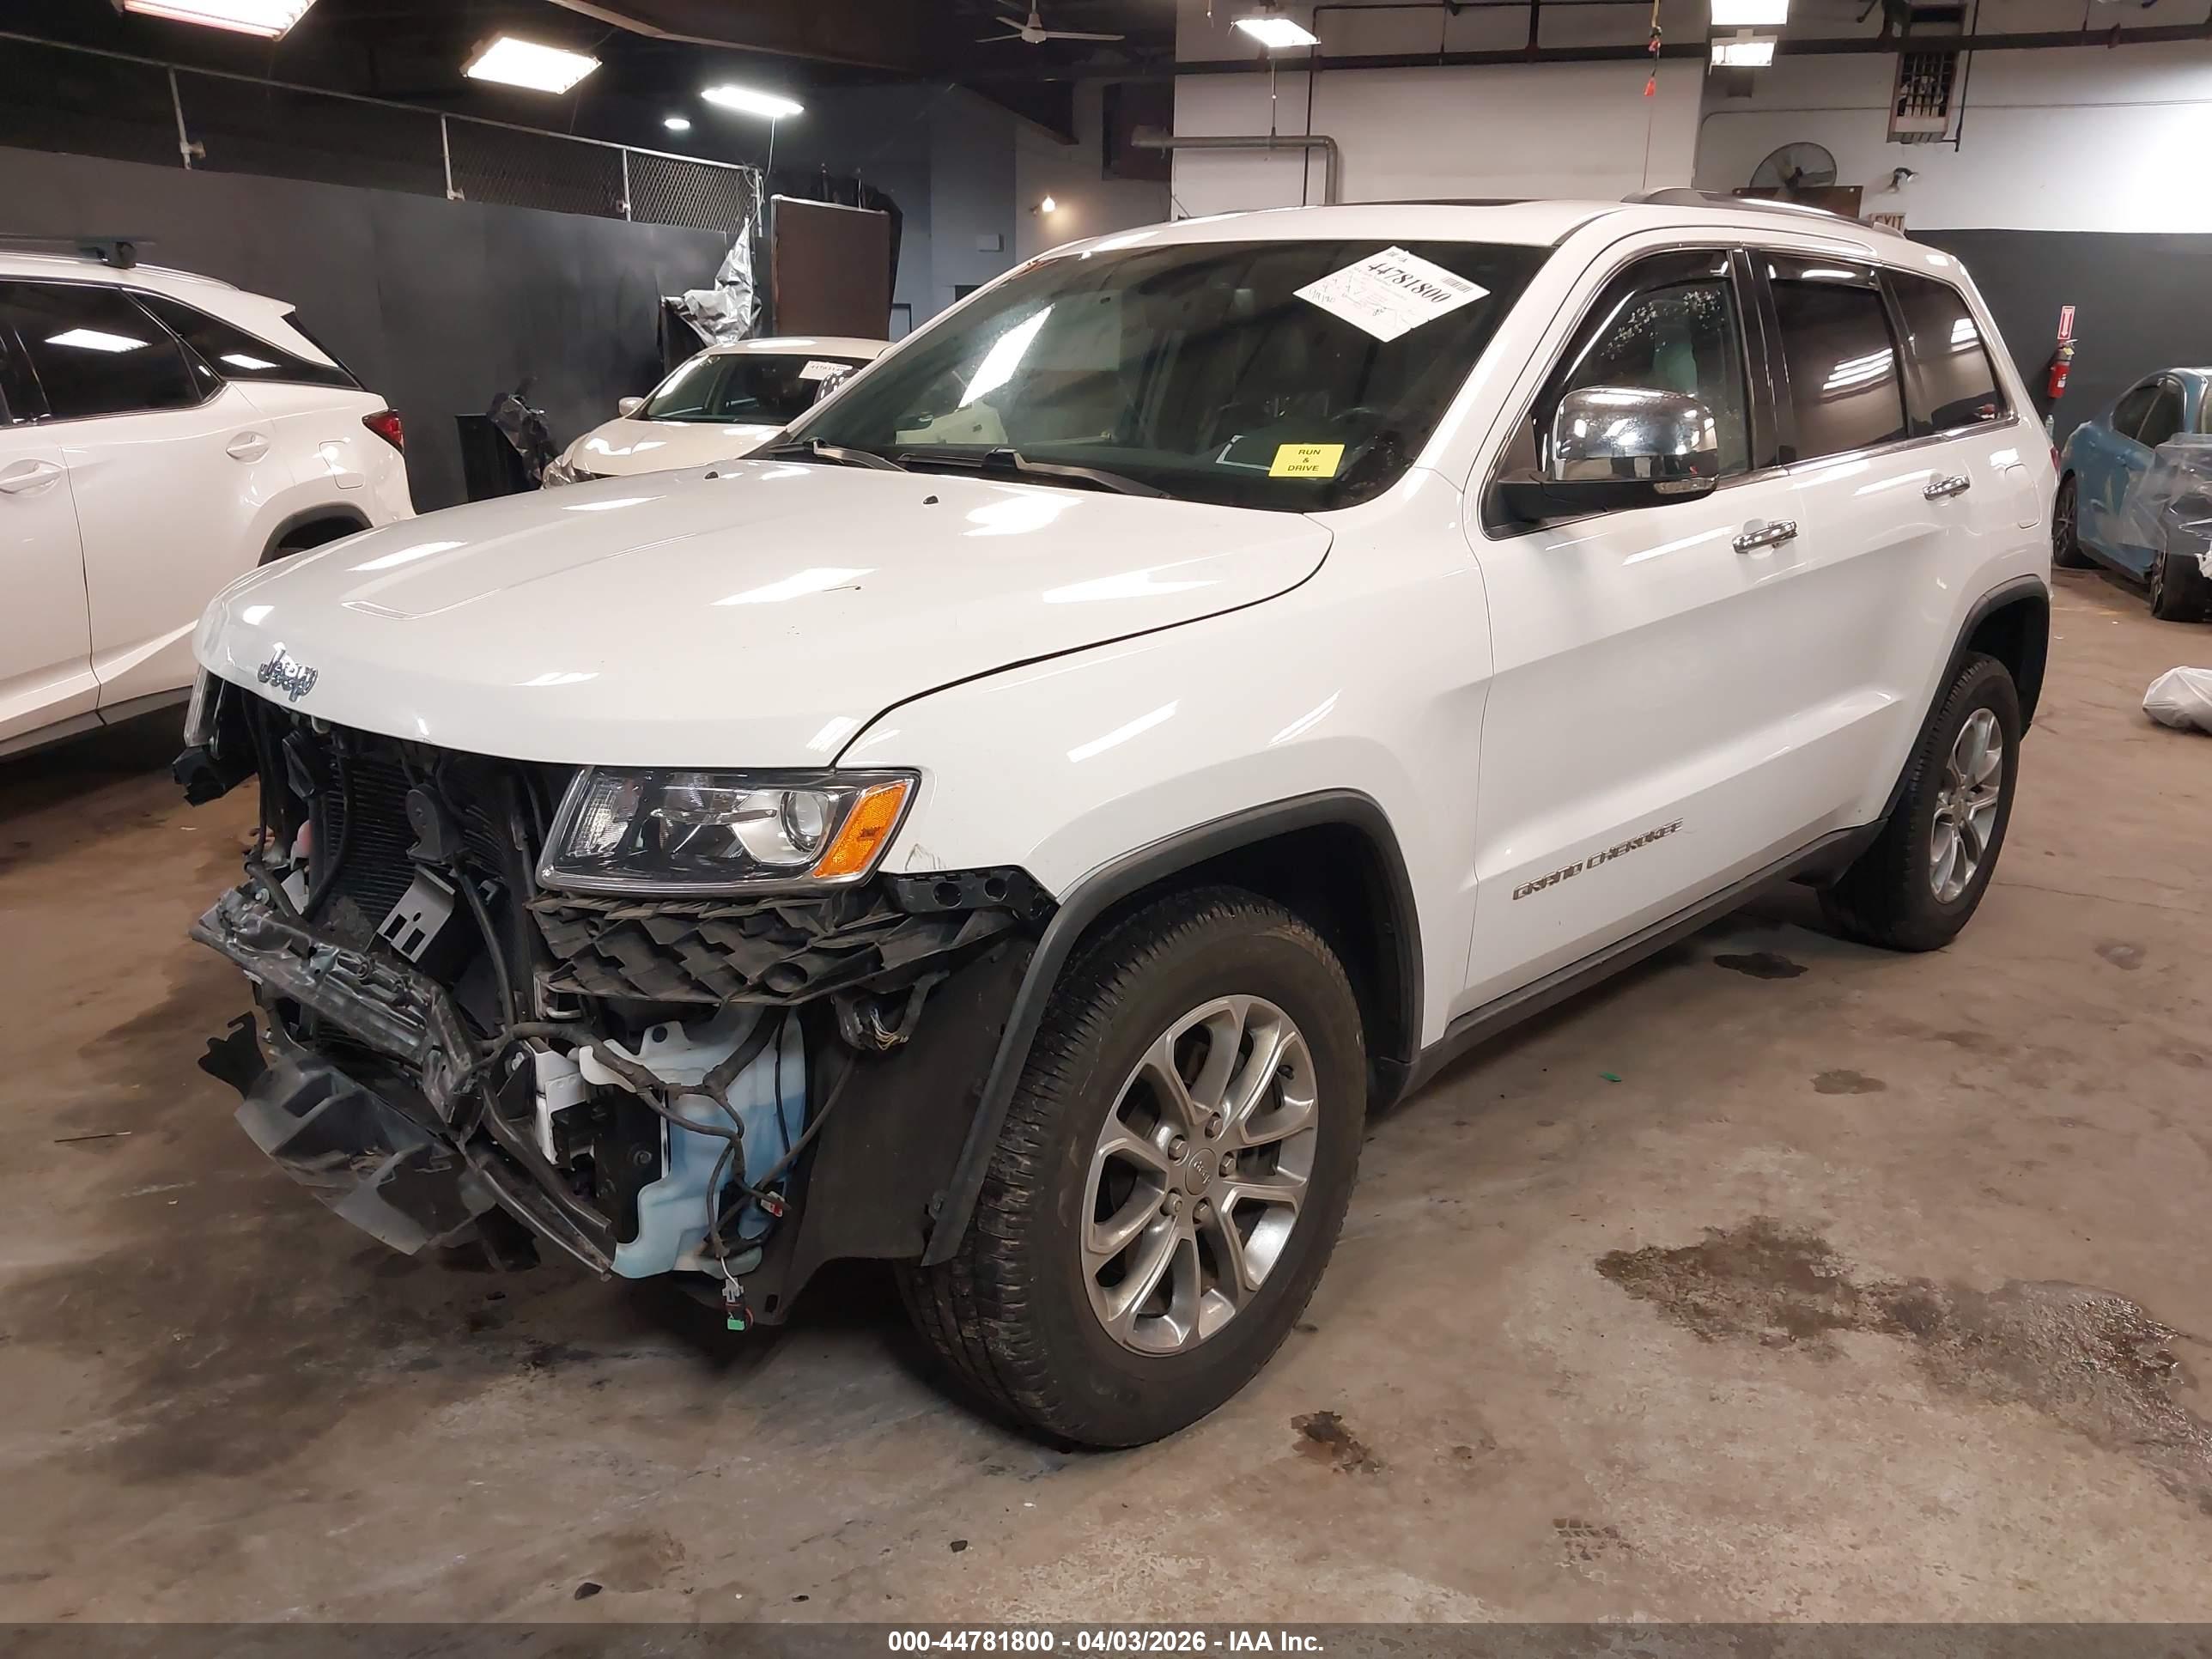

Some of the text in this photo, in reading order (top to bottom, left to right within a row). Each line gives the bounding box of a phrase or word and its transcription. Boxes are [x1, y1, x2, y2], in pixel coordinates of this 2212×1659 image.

[1367, 262, 1452, 303] 44781800
[258, 642, 318, 702] Jeep
[1512, 817, 1684, 901] GRAND CHEROKEE
